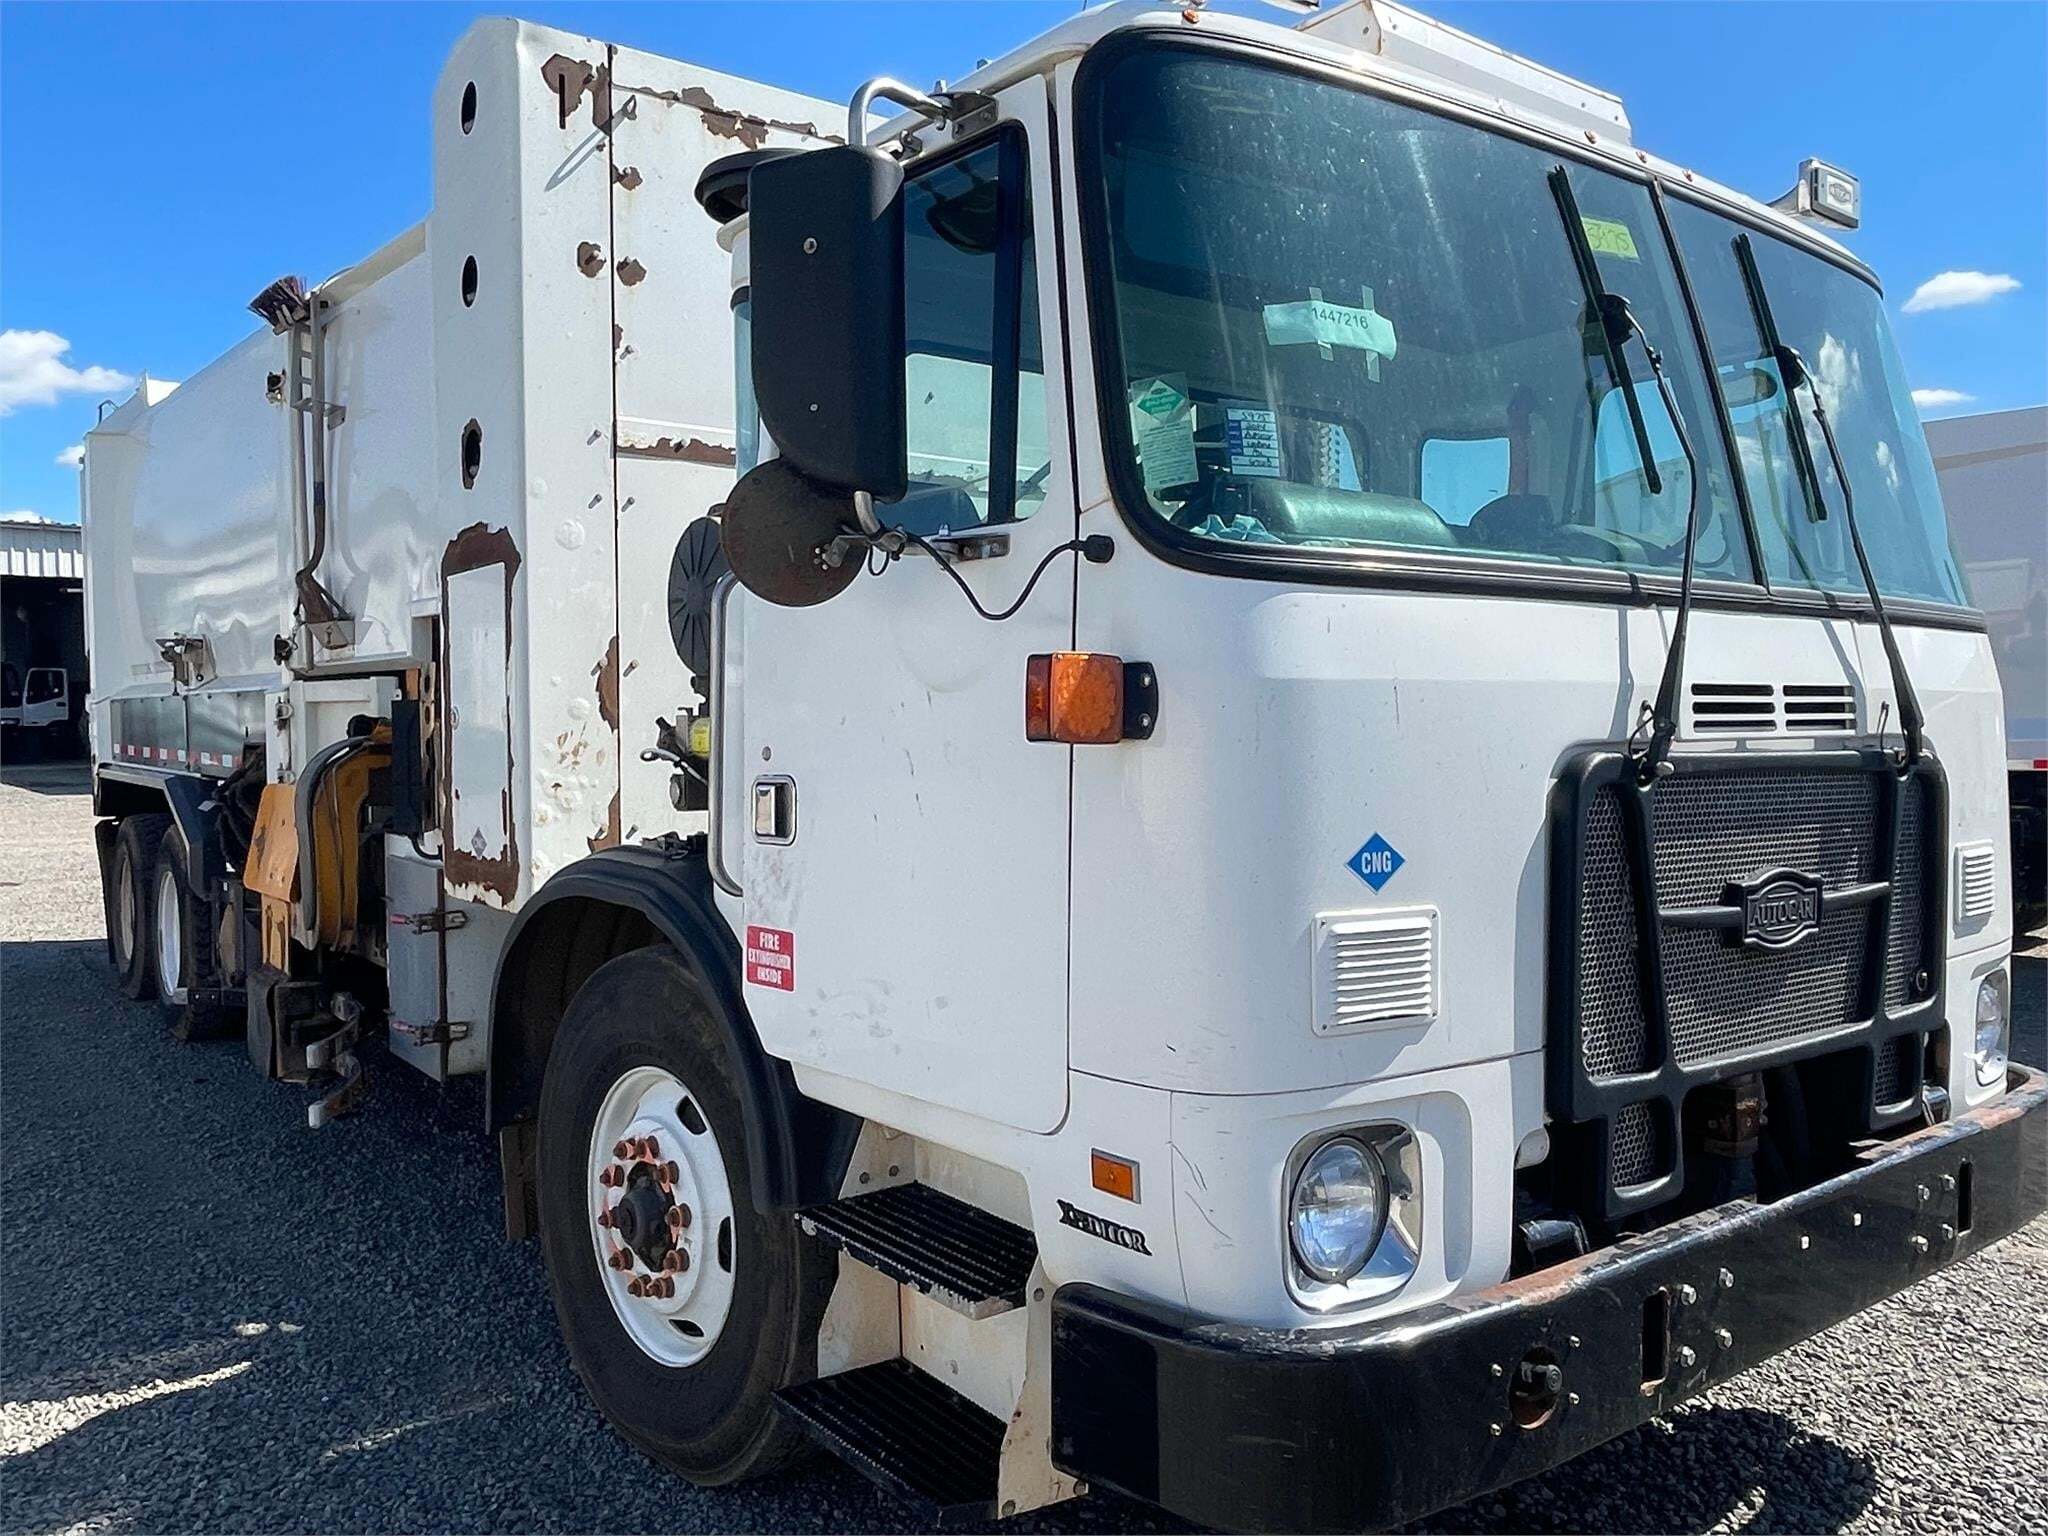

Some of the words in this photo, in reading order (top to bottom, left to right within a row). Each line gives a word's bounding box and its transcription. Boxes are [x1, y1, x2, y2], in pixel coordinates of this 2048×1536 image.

[1311, 306, 1369, 330] 1447216
[1361, 850, 1393, 874] CNG
[1750, 897, 1815, 927] AUTOCAR
[759, 931, 781, 951] FIRE
[757, 966, 783, 985] INSIDE
